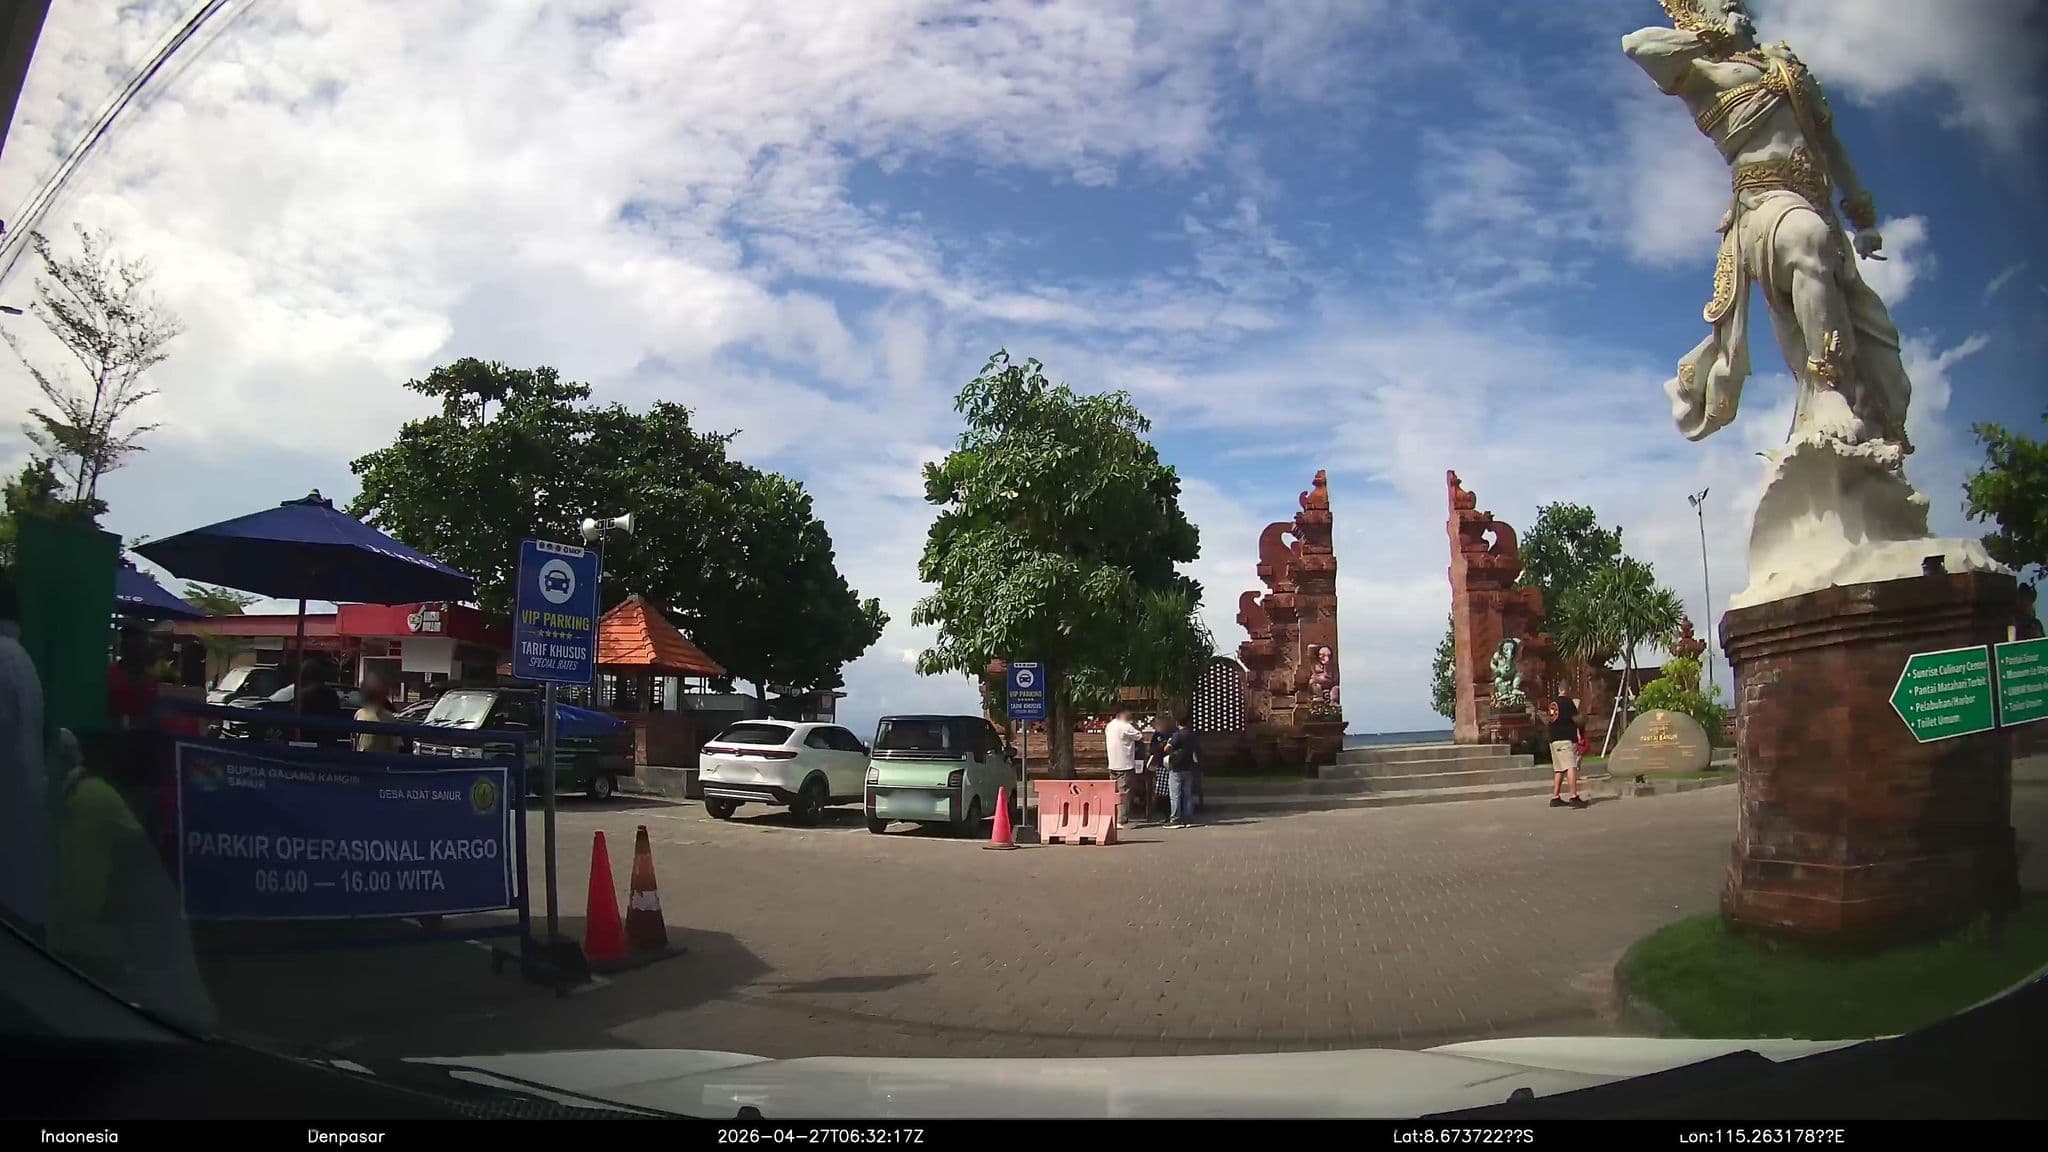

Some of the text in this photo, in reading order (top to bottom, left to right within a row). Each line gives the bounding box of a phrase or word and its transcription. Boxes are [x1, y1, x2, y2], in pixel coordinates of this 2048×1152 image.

[521, 609, 590, 631] VIP PARKING
[521, 641, 587, 660] TARIF KHUSUS
[528, 656, 578, 671] SPECIAL RATES
[1912, 668, 1939, 680] Sunrise
[1938, 664, 1967, 676] Culinary
[1914, 682, 1937, 696] Pantai
[1937, 679, 1967, 692] Matahari
[1917, 716, 1937, 729] Toilet
[378, 789, 462, 801] DESA ADAT SANUR
[187, 831, 498, 862] PARKIR OPERASIONAL KARGO
[255, 869, 309, 893] 06.00
[340, 869, 391, 893] 16.00
[397, 869, 446, 891] WITA
